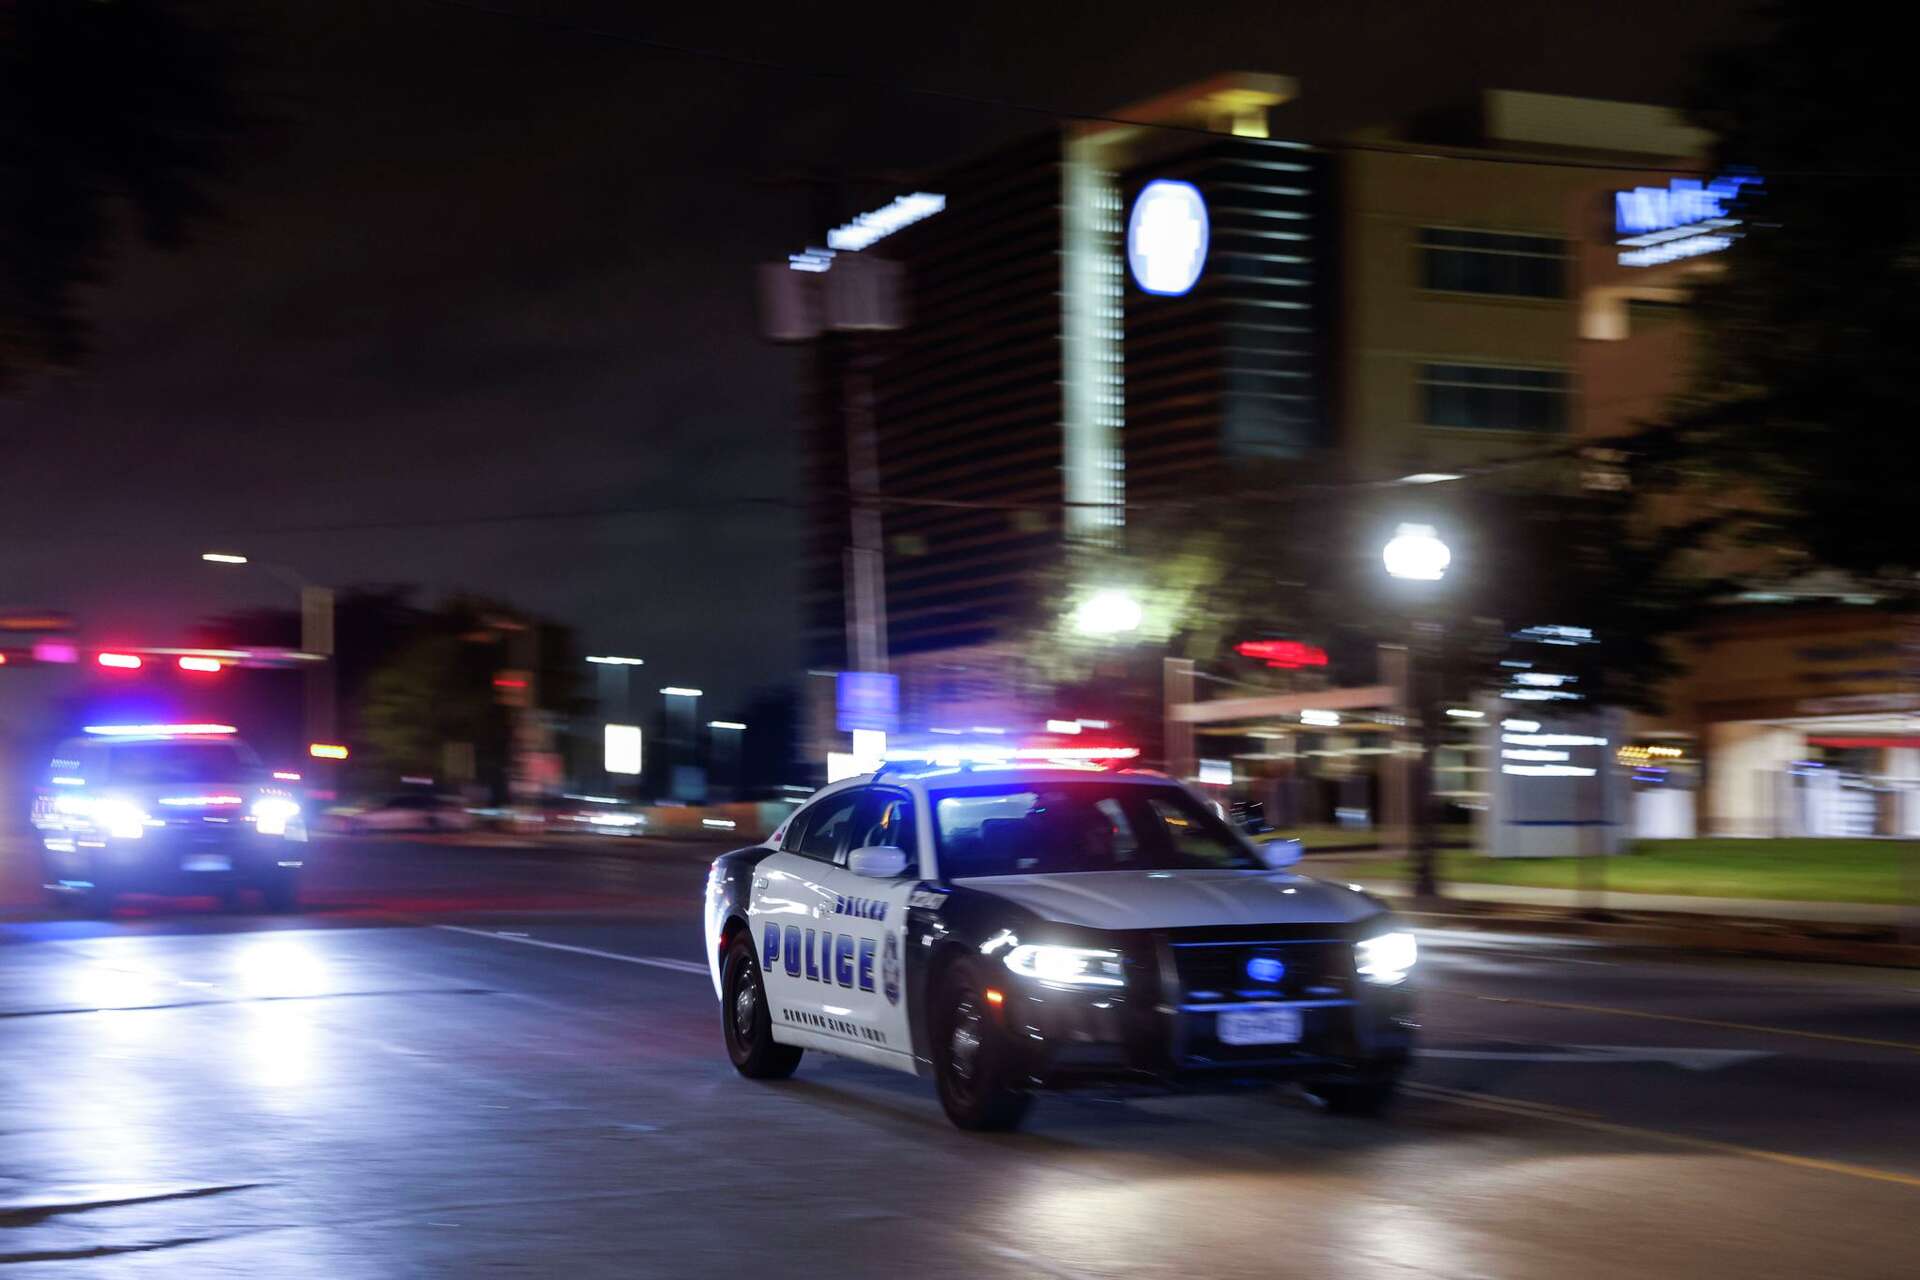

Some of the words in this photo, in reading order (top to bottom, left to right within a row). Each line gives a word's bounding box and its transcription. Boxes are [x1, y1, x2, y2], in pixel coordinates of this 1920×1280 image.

[763, 921, 877, 994] POLICE
[783, 1008, 826, 1029] SERVING
[828, 1018, 859, 1038] SINCE
